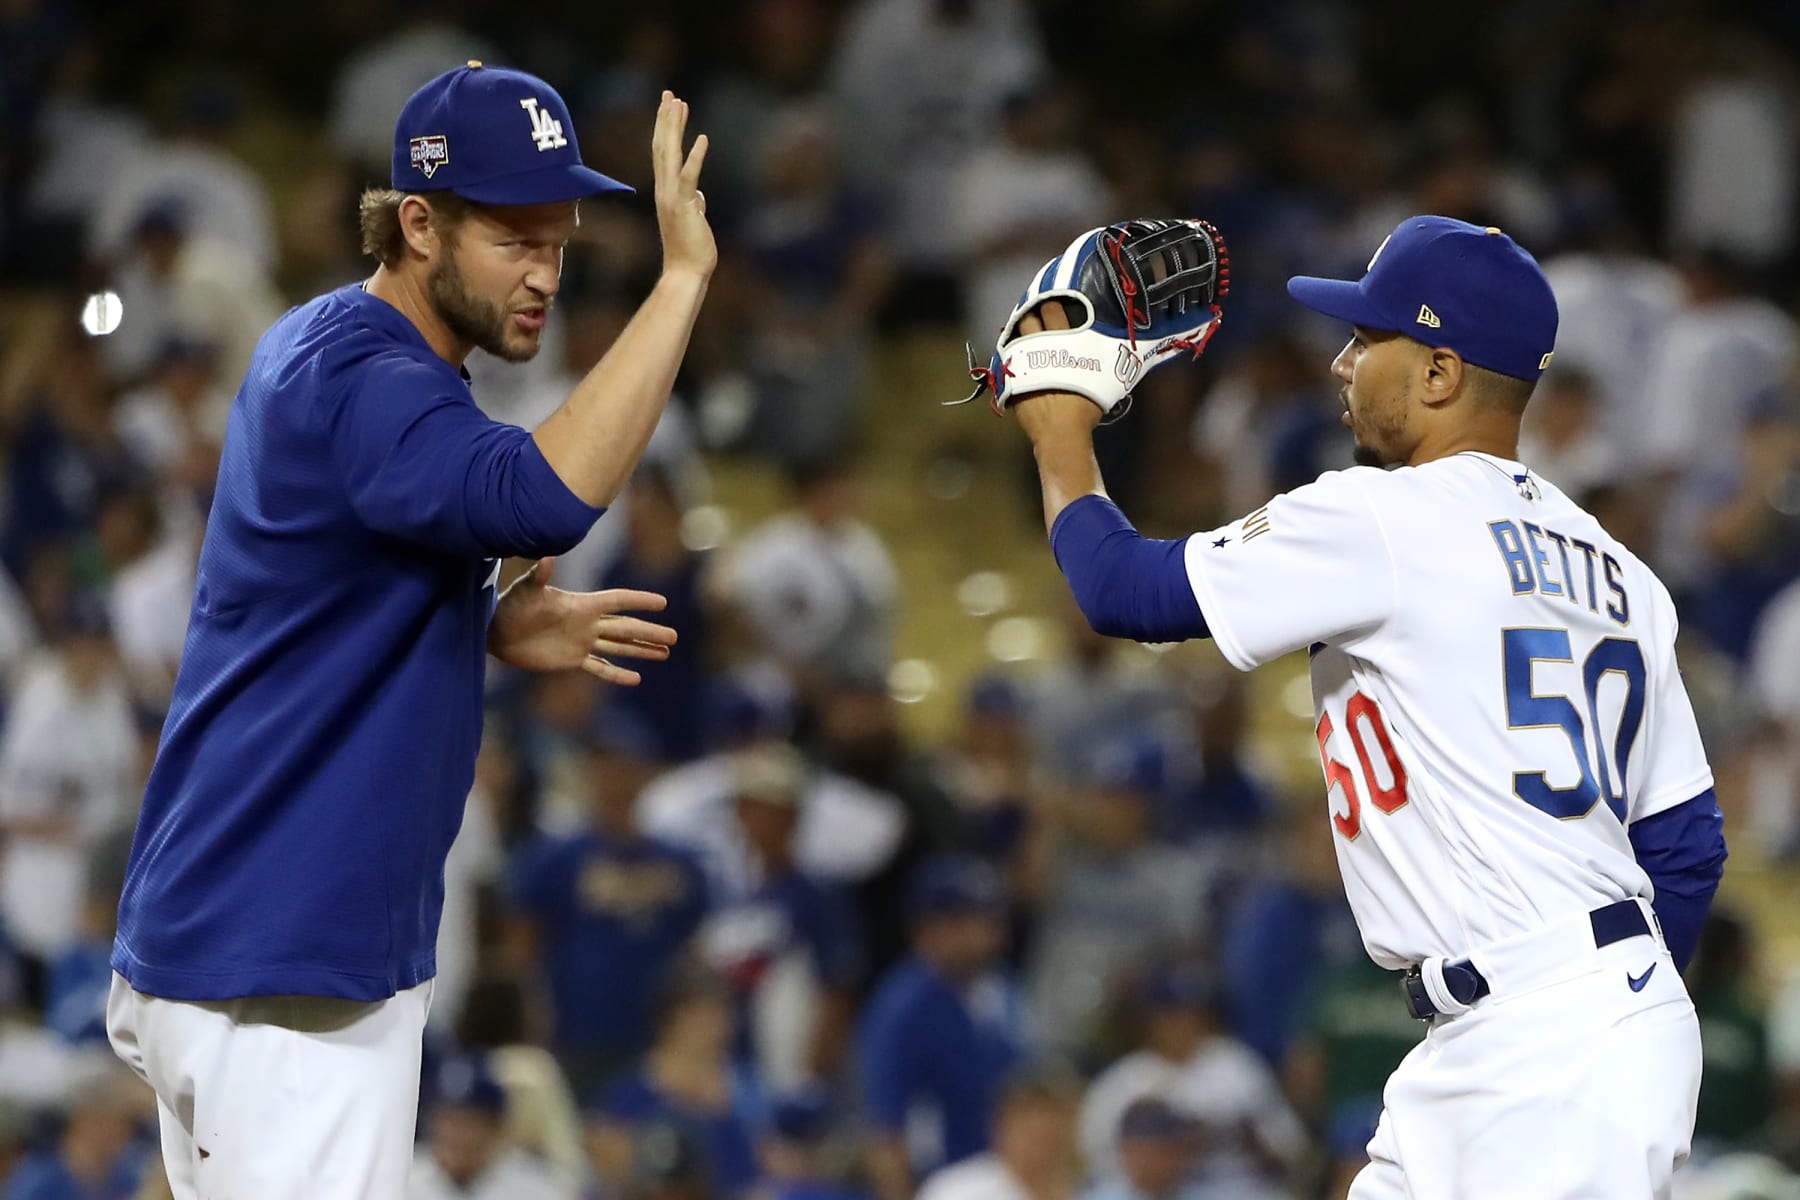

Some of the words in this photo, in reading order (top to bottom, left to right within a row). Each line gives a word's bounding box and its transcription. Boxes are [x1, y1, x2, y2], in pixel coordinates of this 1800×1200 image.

[520, 97, 567, 151] LA
[1027, 349, 1102, 372] Wilson
[1487, 518, 1630, 627] BETTS
[1316, 690, 1409, 843] 50
[1501, 626, 1647, 825] 50
